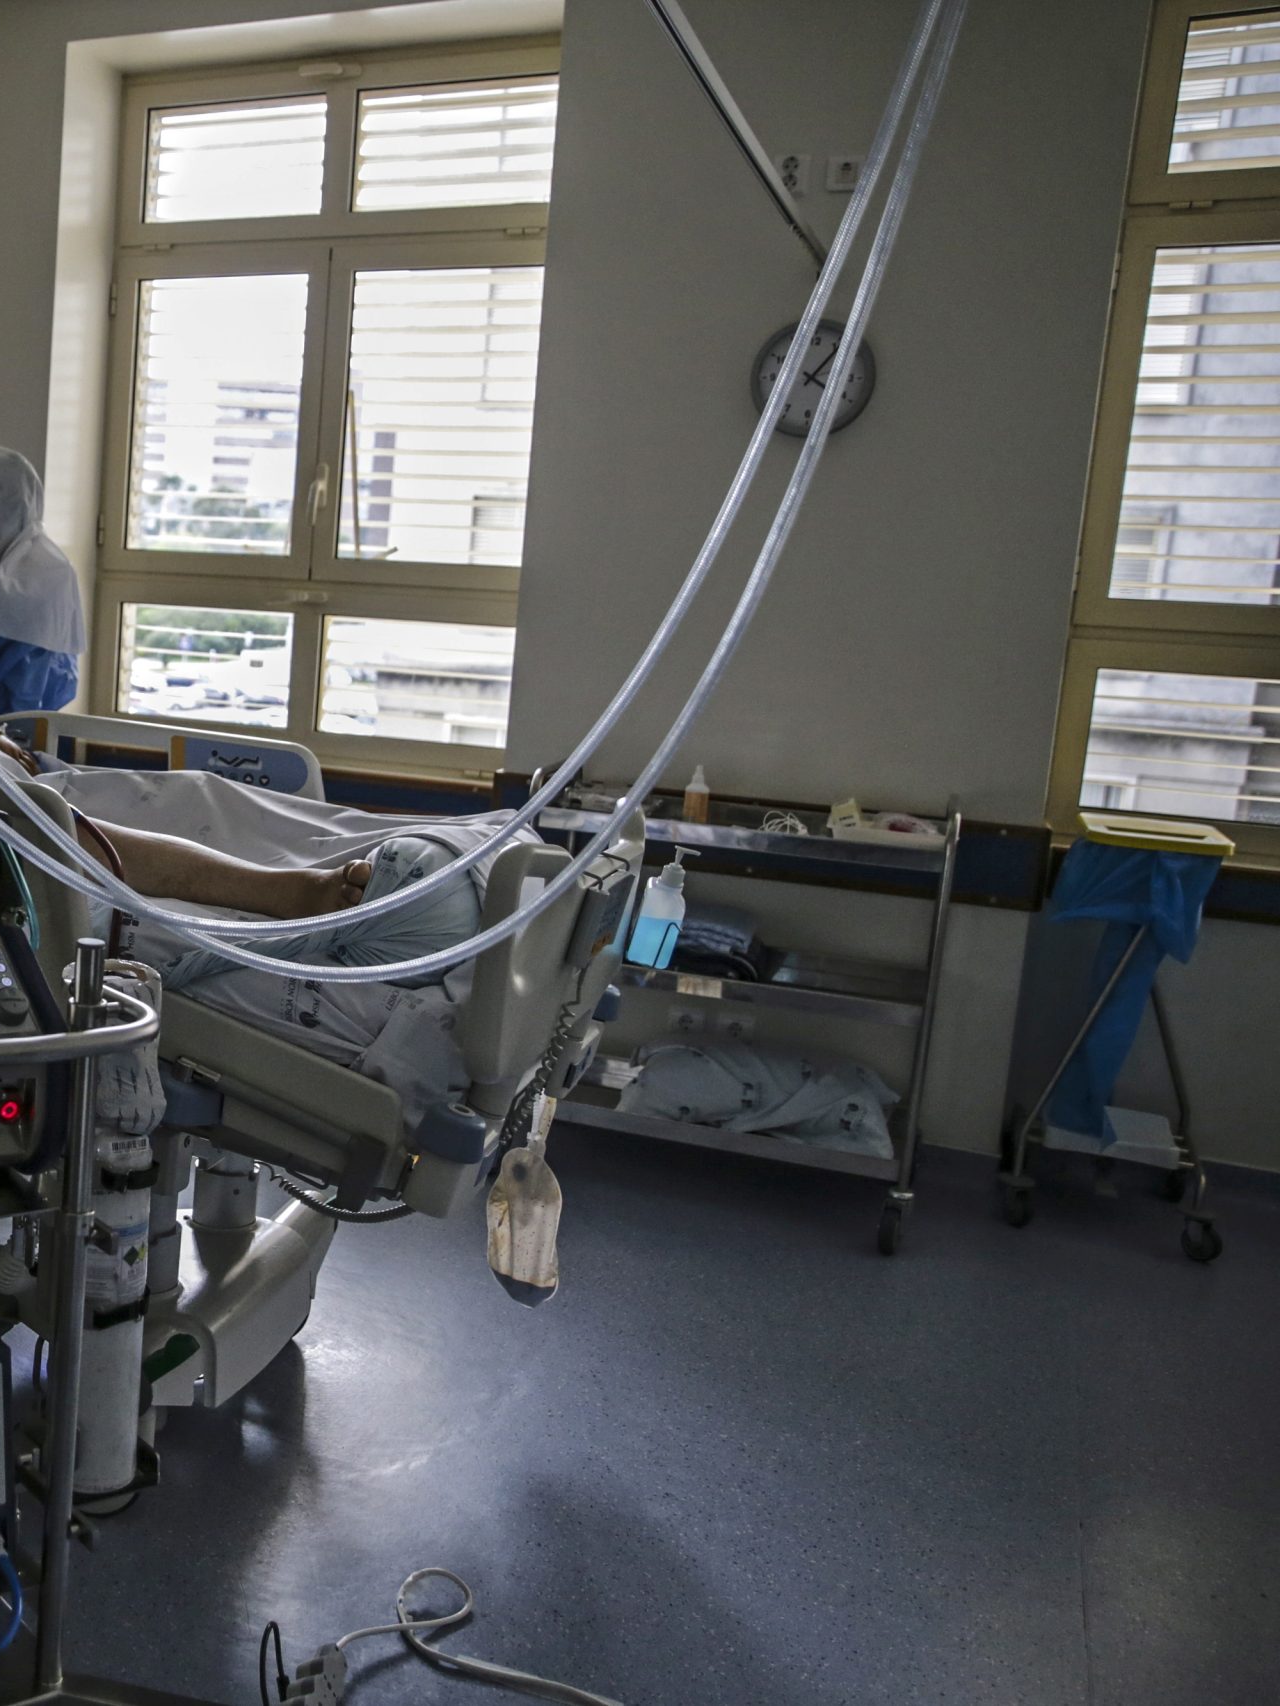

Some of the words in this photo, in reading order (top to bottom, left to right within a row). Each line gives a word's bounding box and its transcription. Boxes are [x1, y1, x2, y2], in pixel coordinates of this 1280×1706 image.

[811, 337, 821, 346] 12
[769, 373, 776, 382] 9
[784, 403, 792, 413] 7
[804, 409, 812, 418] 6
[287, 977, 297, 998] NOR
